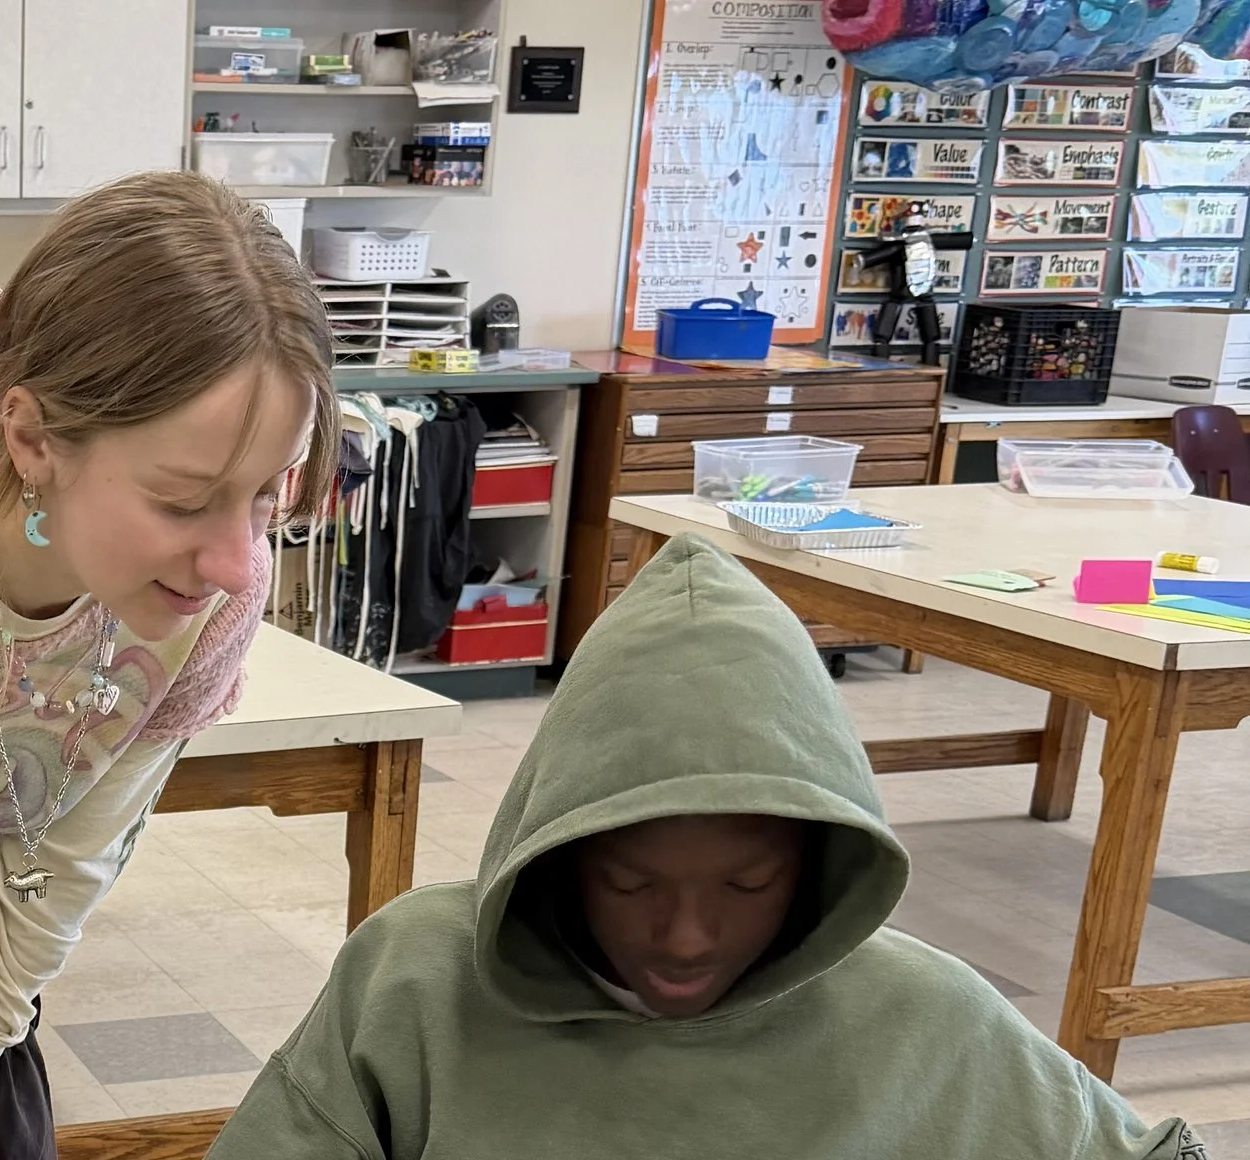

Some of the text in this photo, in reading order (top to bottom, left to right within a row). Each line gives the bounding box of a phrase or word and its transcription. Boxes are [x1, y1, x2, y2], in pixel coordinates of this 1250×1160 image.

[1071, 90, 1130, 110] Contrast
[933, 143, 968, 163] Value
[1062, 144, 1120, 165] Emphasis
[1054, 200, 1111, 215] Movement
[1197, 199, 1237, 215] Gesture
[1049, 254, 1099, 273] Pattern
